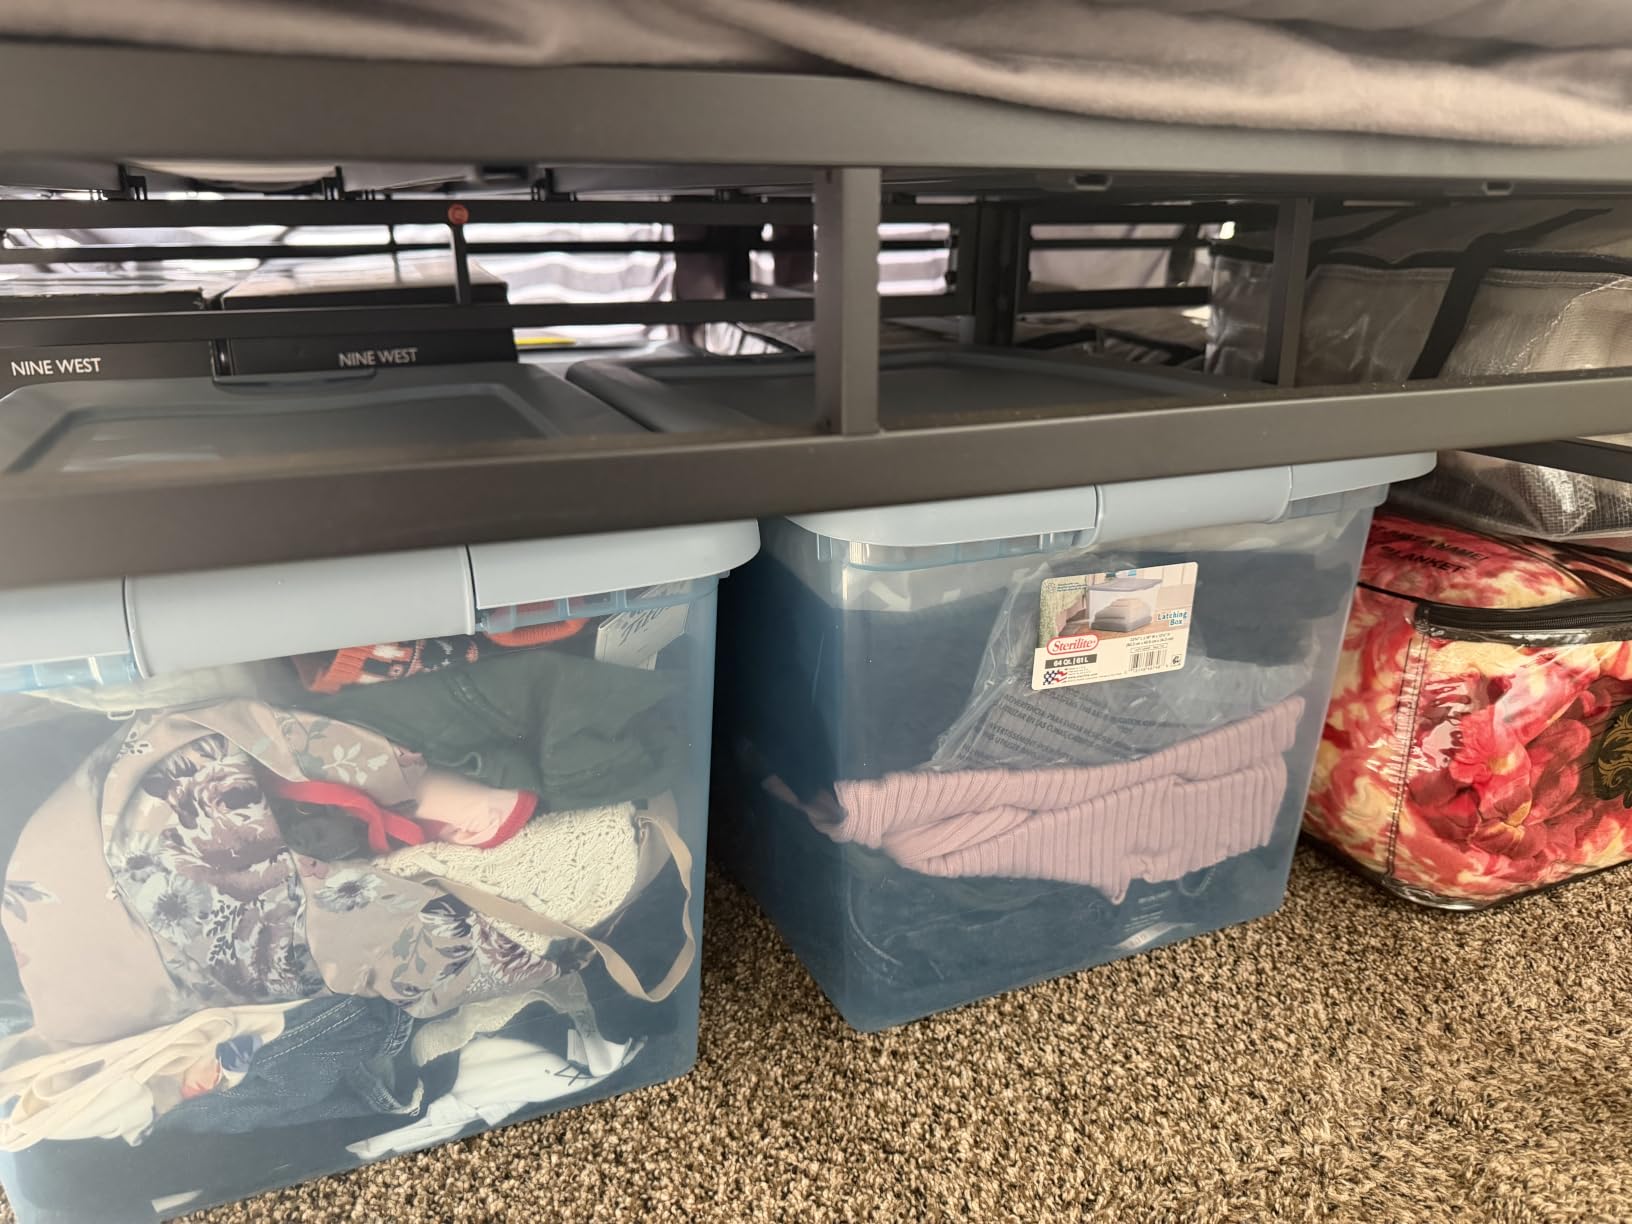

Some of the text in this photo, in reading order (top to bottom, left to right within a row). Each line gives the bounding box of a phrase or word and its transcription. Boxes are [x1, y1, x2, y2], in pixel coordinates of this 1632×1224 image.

[338, 347, 418, 367] NINE WEST
[11, 357, 101, 376] NINE WEST
[1381, 545, 1467, 573] BLANKET
[1157, 611, 1188, 621] Latching
[1169, 618, 1183, 626] Box
[1052, 637, 1094, 653] Sterilite
